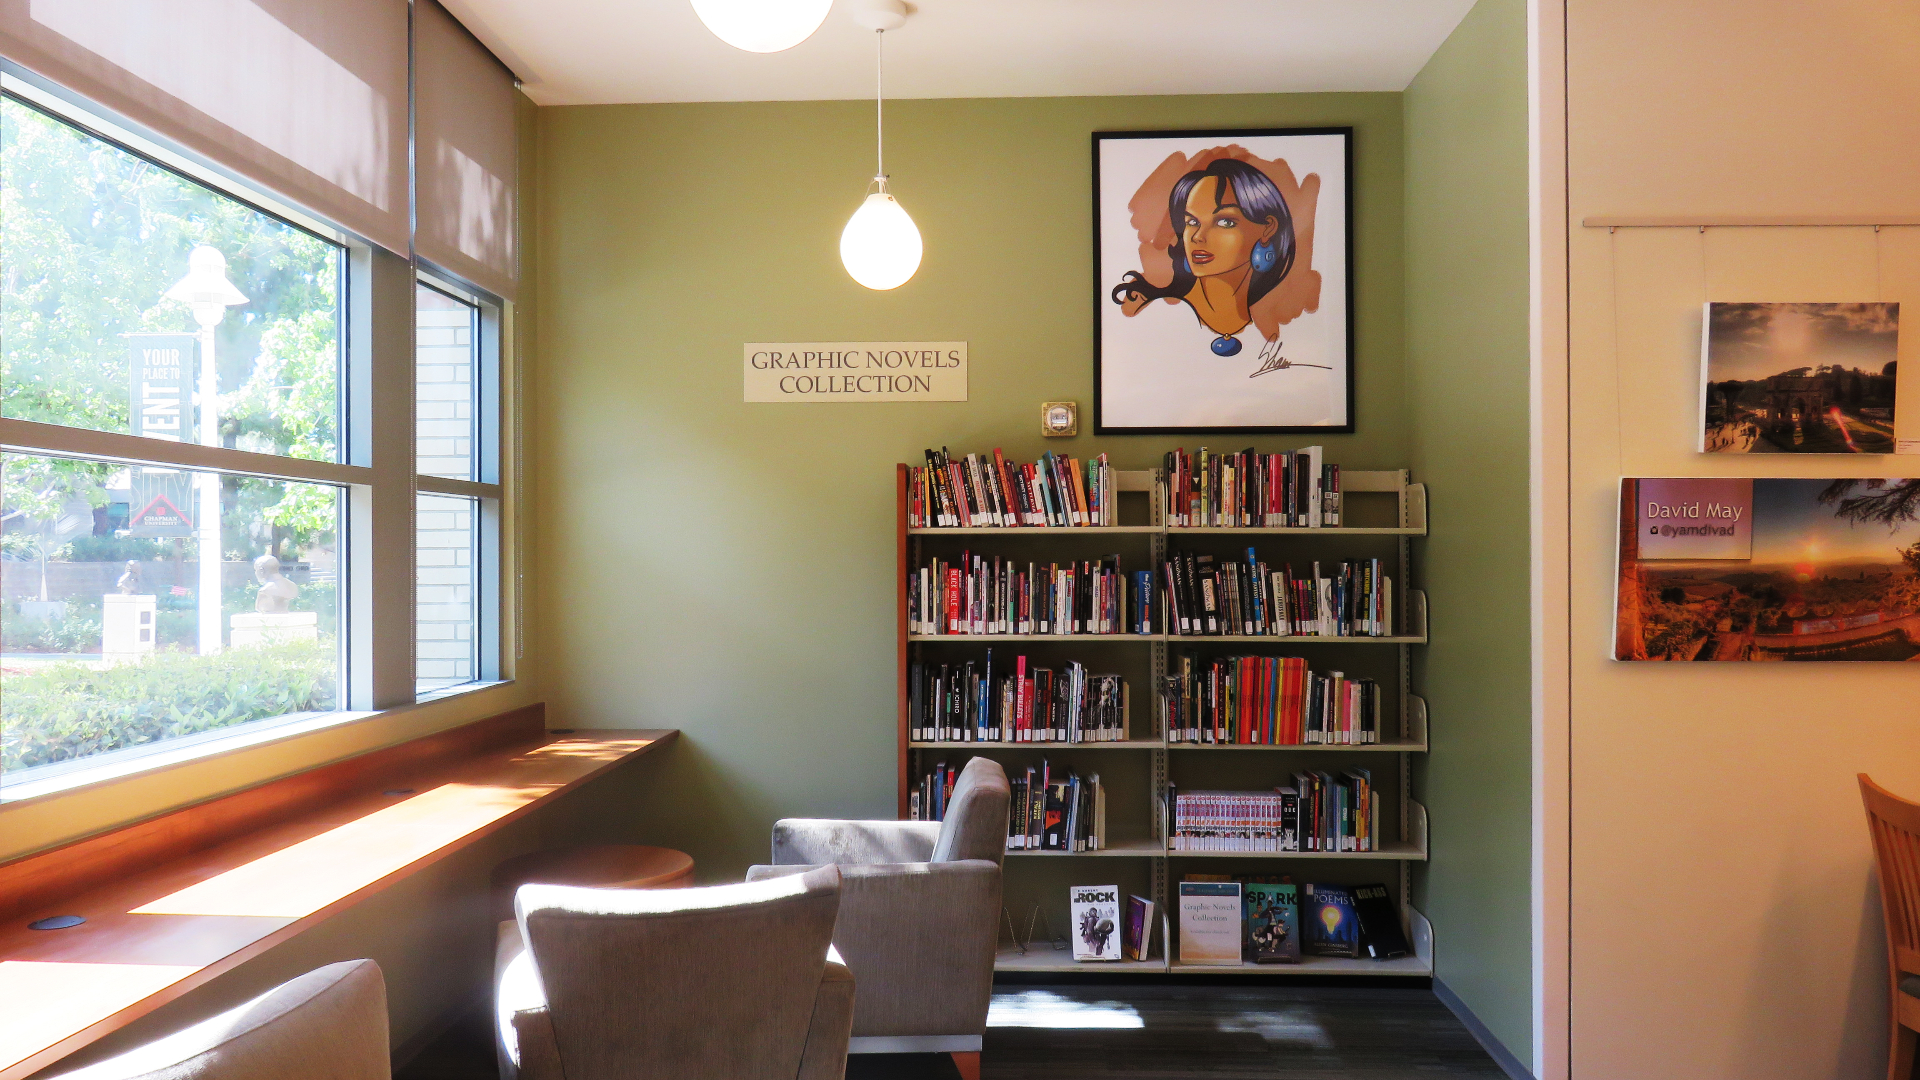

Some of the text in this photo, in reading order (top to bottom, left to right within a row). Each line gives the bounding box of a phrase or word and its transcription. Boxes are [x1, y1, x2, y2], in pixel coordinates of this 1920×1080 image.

[142, 348, 180, 366] YOUR
[751, 349, 960, 370] GRAPHIC NOVELS
[142, 367, 180, 380] PLACE TO
[779, 374, 932, 394] COLLECTION
[1648, 501, 1743, 522] David May
[1660, 524, 1735, 539] @yamdivad
[950, 569, 958, 589] BLACK
[950, 590, 958, 607] HOLE
[1203, 579, 1211, 611] SANDMAN
[1017, 693, 1025, 719] BULLETS
[1078, 891, 1116, 904] ROCK
[1313, 894, 1349, 905] POEMS
[1355, 886, 1387, 900] KICK-ASS
[1183, 903, 1236, 913] Graphic Novels
[1192, 914, 1228, 922] Collection
